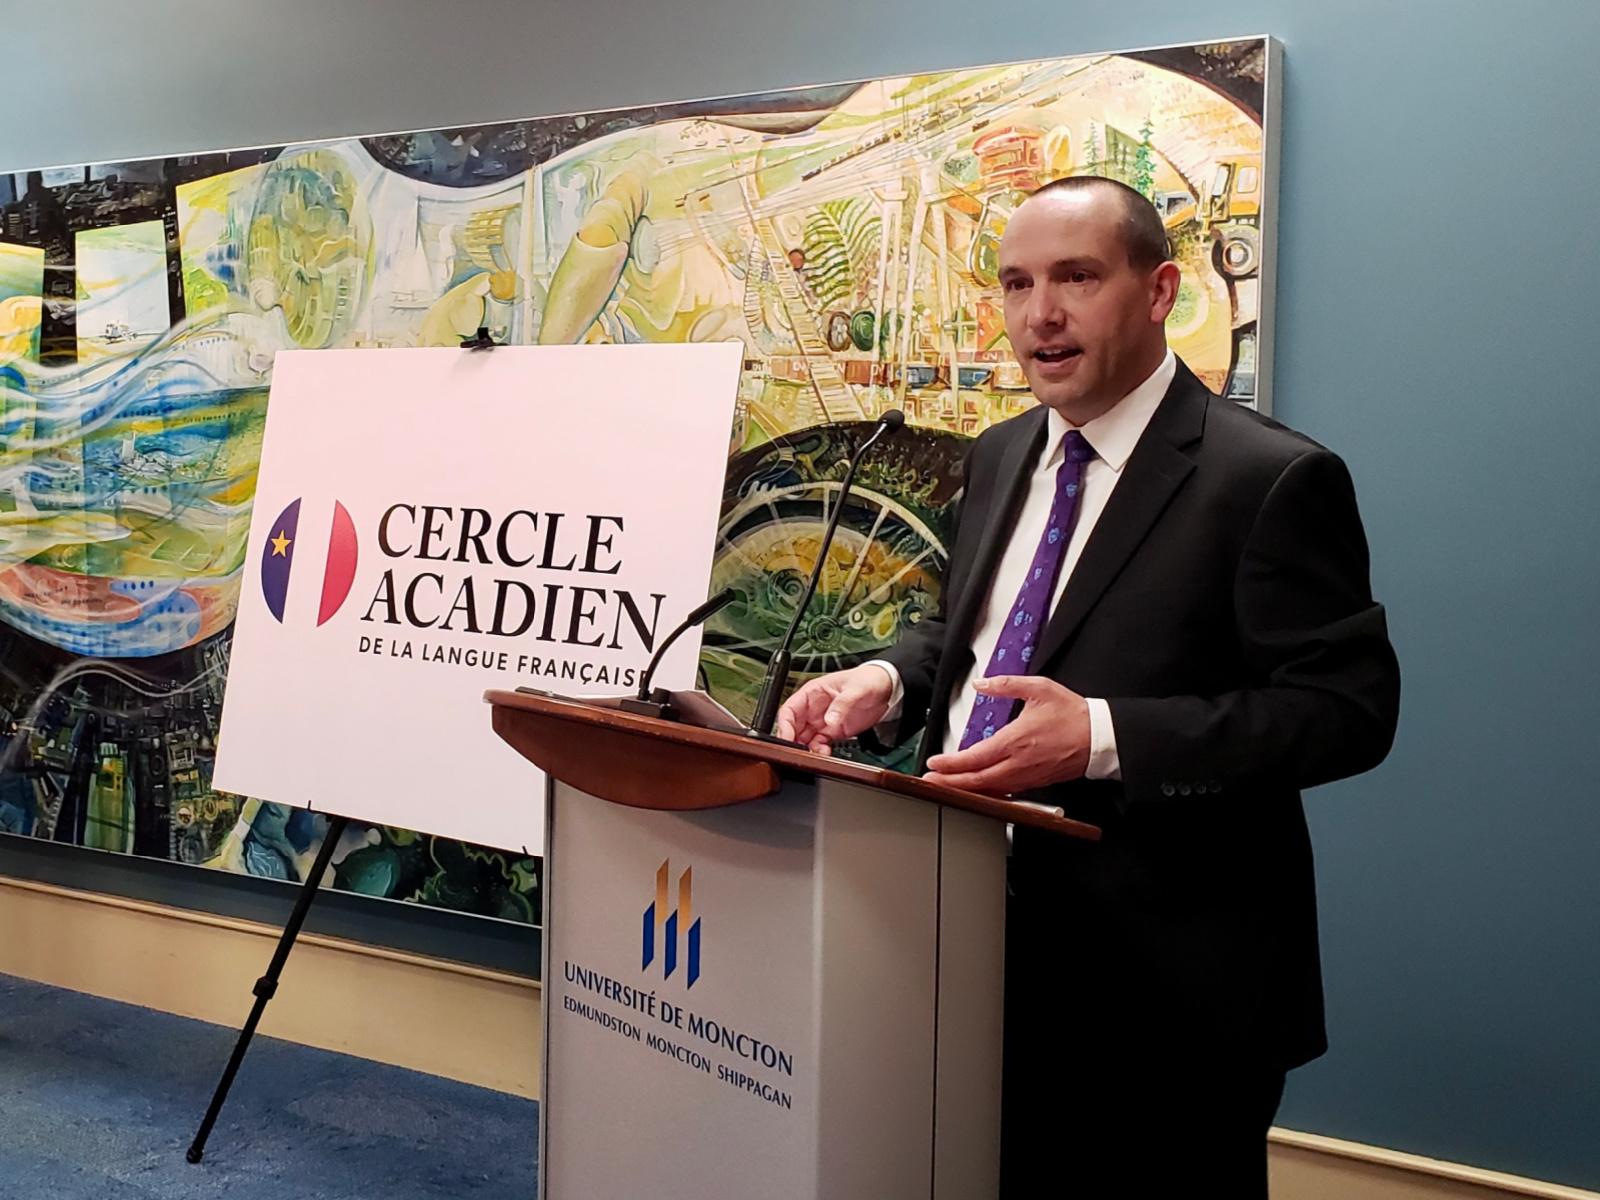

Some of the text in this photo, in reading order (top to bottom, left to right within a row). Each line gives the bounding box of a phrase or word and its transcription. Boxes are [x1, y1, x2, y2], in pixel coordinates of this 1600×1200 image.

[377, 503, 624, 575] CERCLE
[358, 636, 384, 655] DE
[390, 639, 413, 659] LA
[422, 643, 509, 671] LANGUE
[360, 568, 667, 654] ACADIEN
[563, 994, 792, 1111] EDMUNDSTON MONCTON SHIPPAGAN
[564, 960, 793, 1077] UNIVERSITÉ DE MONCTON
